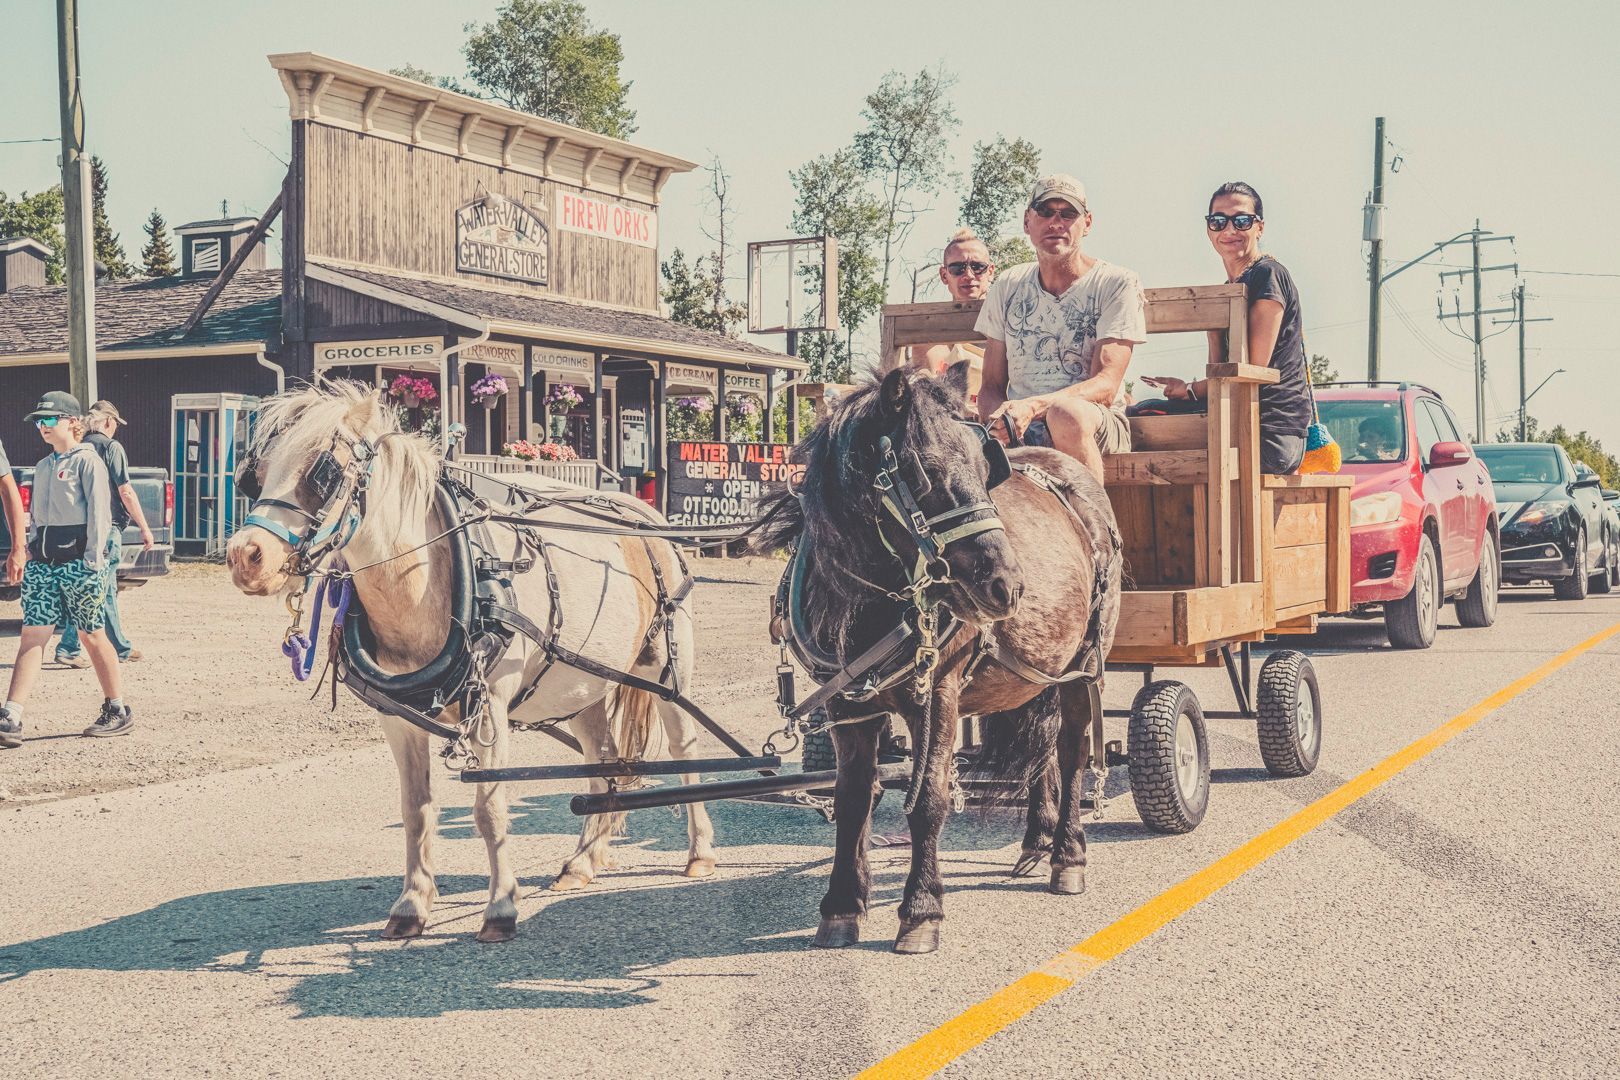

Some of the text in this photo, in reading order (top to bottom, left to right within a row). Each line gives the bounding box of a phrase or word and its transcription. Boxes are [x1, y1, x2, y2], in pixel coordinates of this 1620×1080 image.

[324, 343, 434, 360] GROCERIES
[532, 352, 588, 369] COLD DRINKS
[682, 367, 715, 386] CREAM
[725, 375, 761, 388] COFFEE
[680, 442, 792, 464] WATER VALLEY
[685, 462, 808, 483] GENERAL STORE
[722, 480, 760, 498] OPEN
